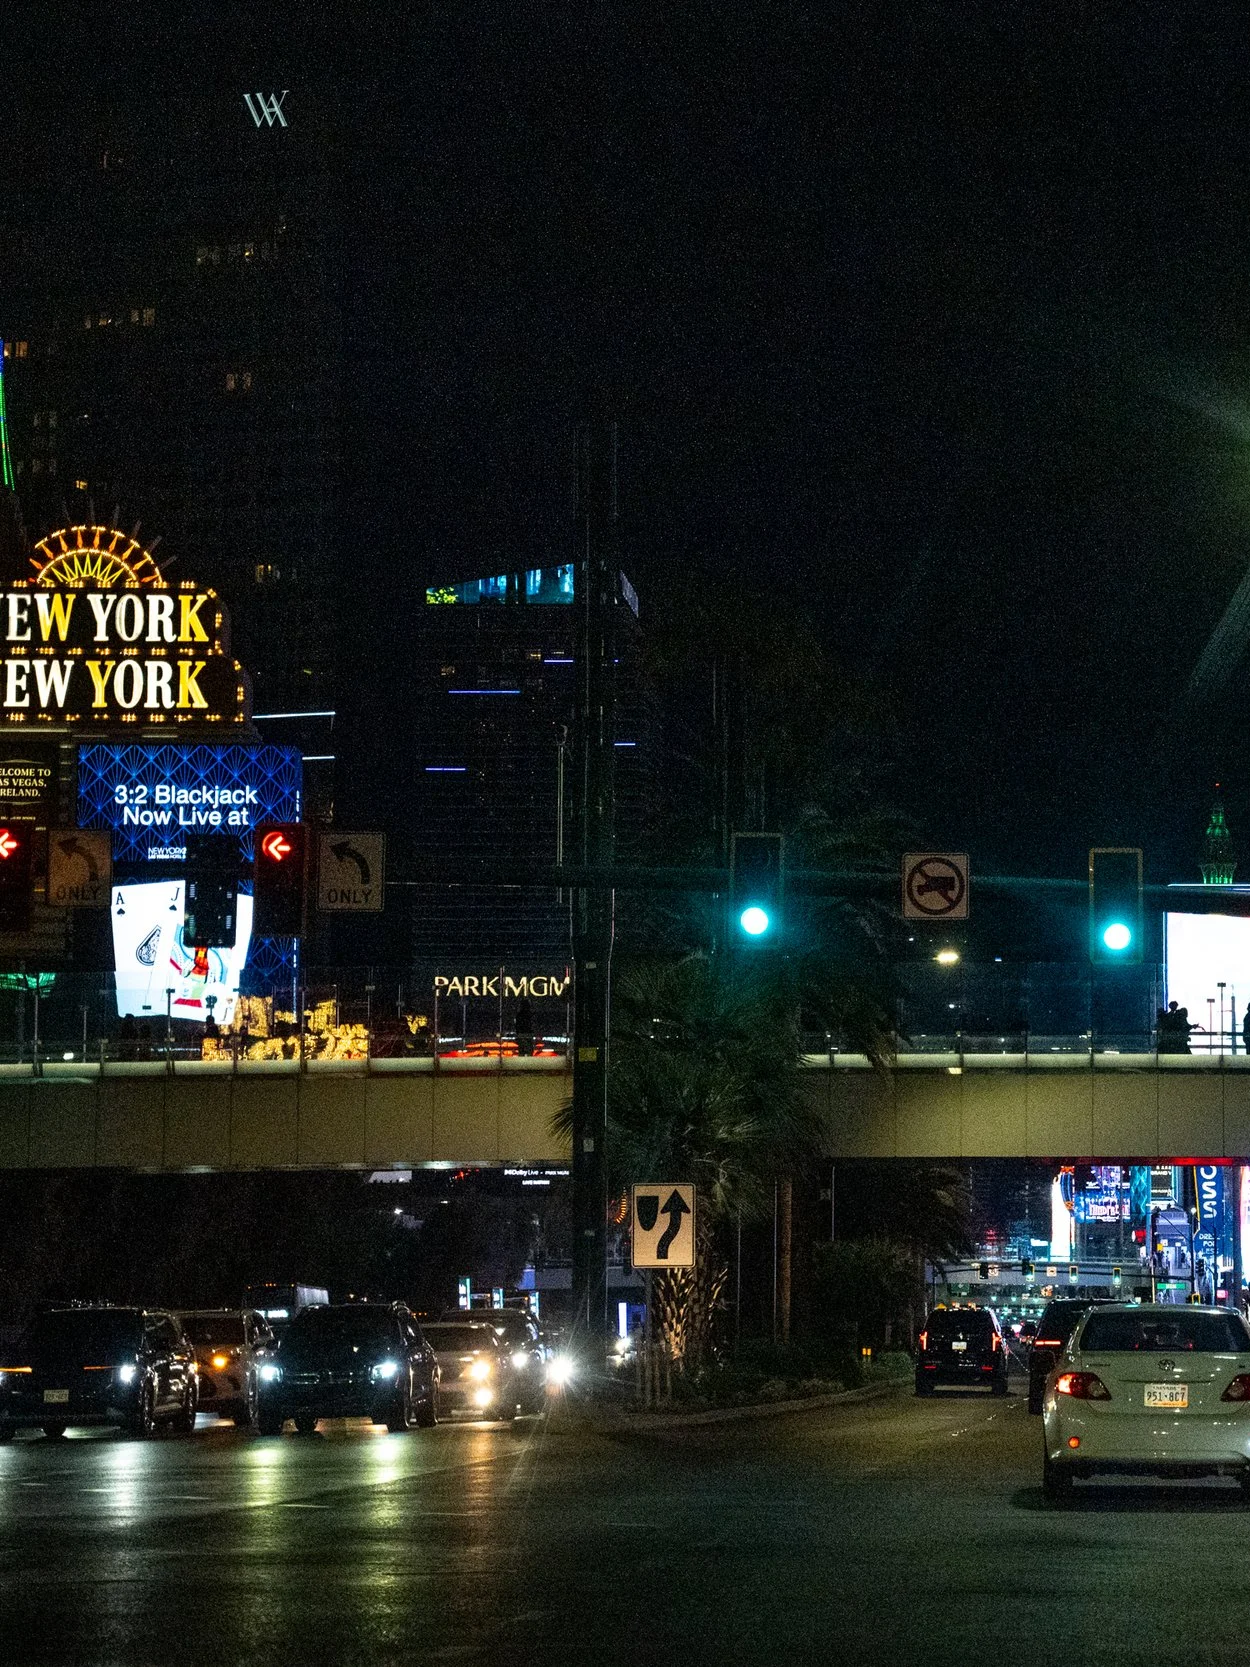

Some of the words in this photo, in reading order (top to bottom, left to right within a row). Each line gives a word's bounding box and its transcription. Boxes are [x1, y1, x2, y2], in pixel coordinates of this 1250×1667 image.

[0, 593, 76, 642] EW
[87, 593, 210, 643] YORK
[0, 659, 75, 708] EW
[85, 659, 209, 709] YORK
[37, 768, 51, 776] TO
[114, 785, 148, 804] 3:2
[155, 784, 258, 809] Blackjack
[123, 806, 172, 826] Now
[179, 806, 222, 826] Live
[228, 807, 249, 826] at
[56, 884, 101, 900] ONLY
[328, 888, 372, 903] ONLY
[434, 976, 500, 997] PARK
[504, 976, 571, 997] MGM
